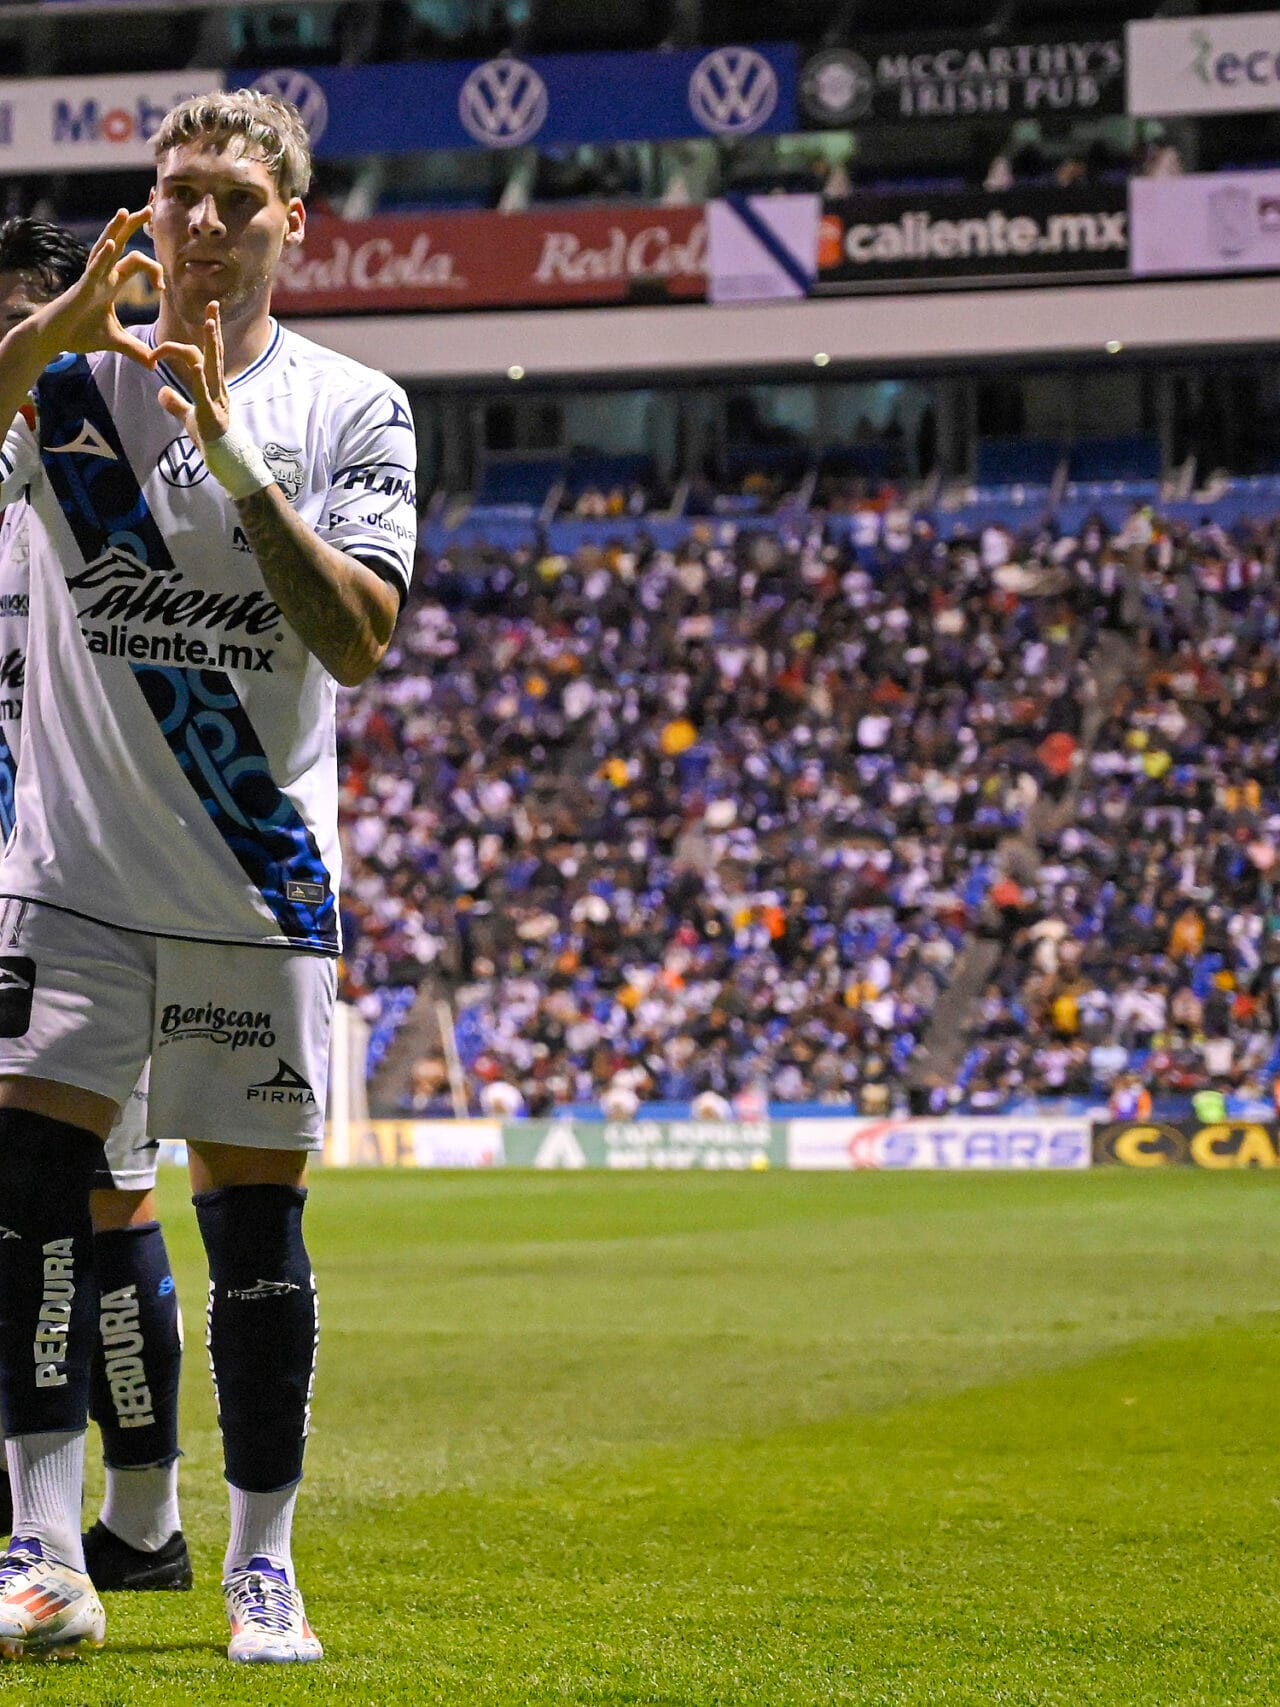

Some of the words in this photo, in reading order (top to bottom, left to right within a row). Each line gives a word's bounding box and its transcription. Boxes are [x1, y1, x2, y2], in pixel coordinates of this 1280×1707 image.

[1024, 75, 1100, 110] PUB
[846, 212, 1130, 265] caliente.mx
[357, 511, 417, 541] otalpla
[160, 1001, 272, 1035] Beriscan
[231, 1029, 277, 1052] pro
[246, 1087, 317, 1105] PIRMA
[33, 1237, 76, 1388] PERDURA
